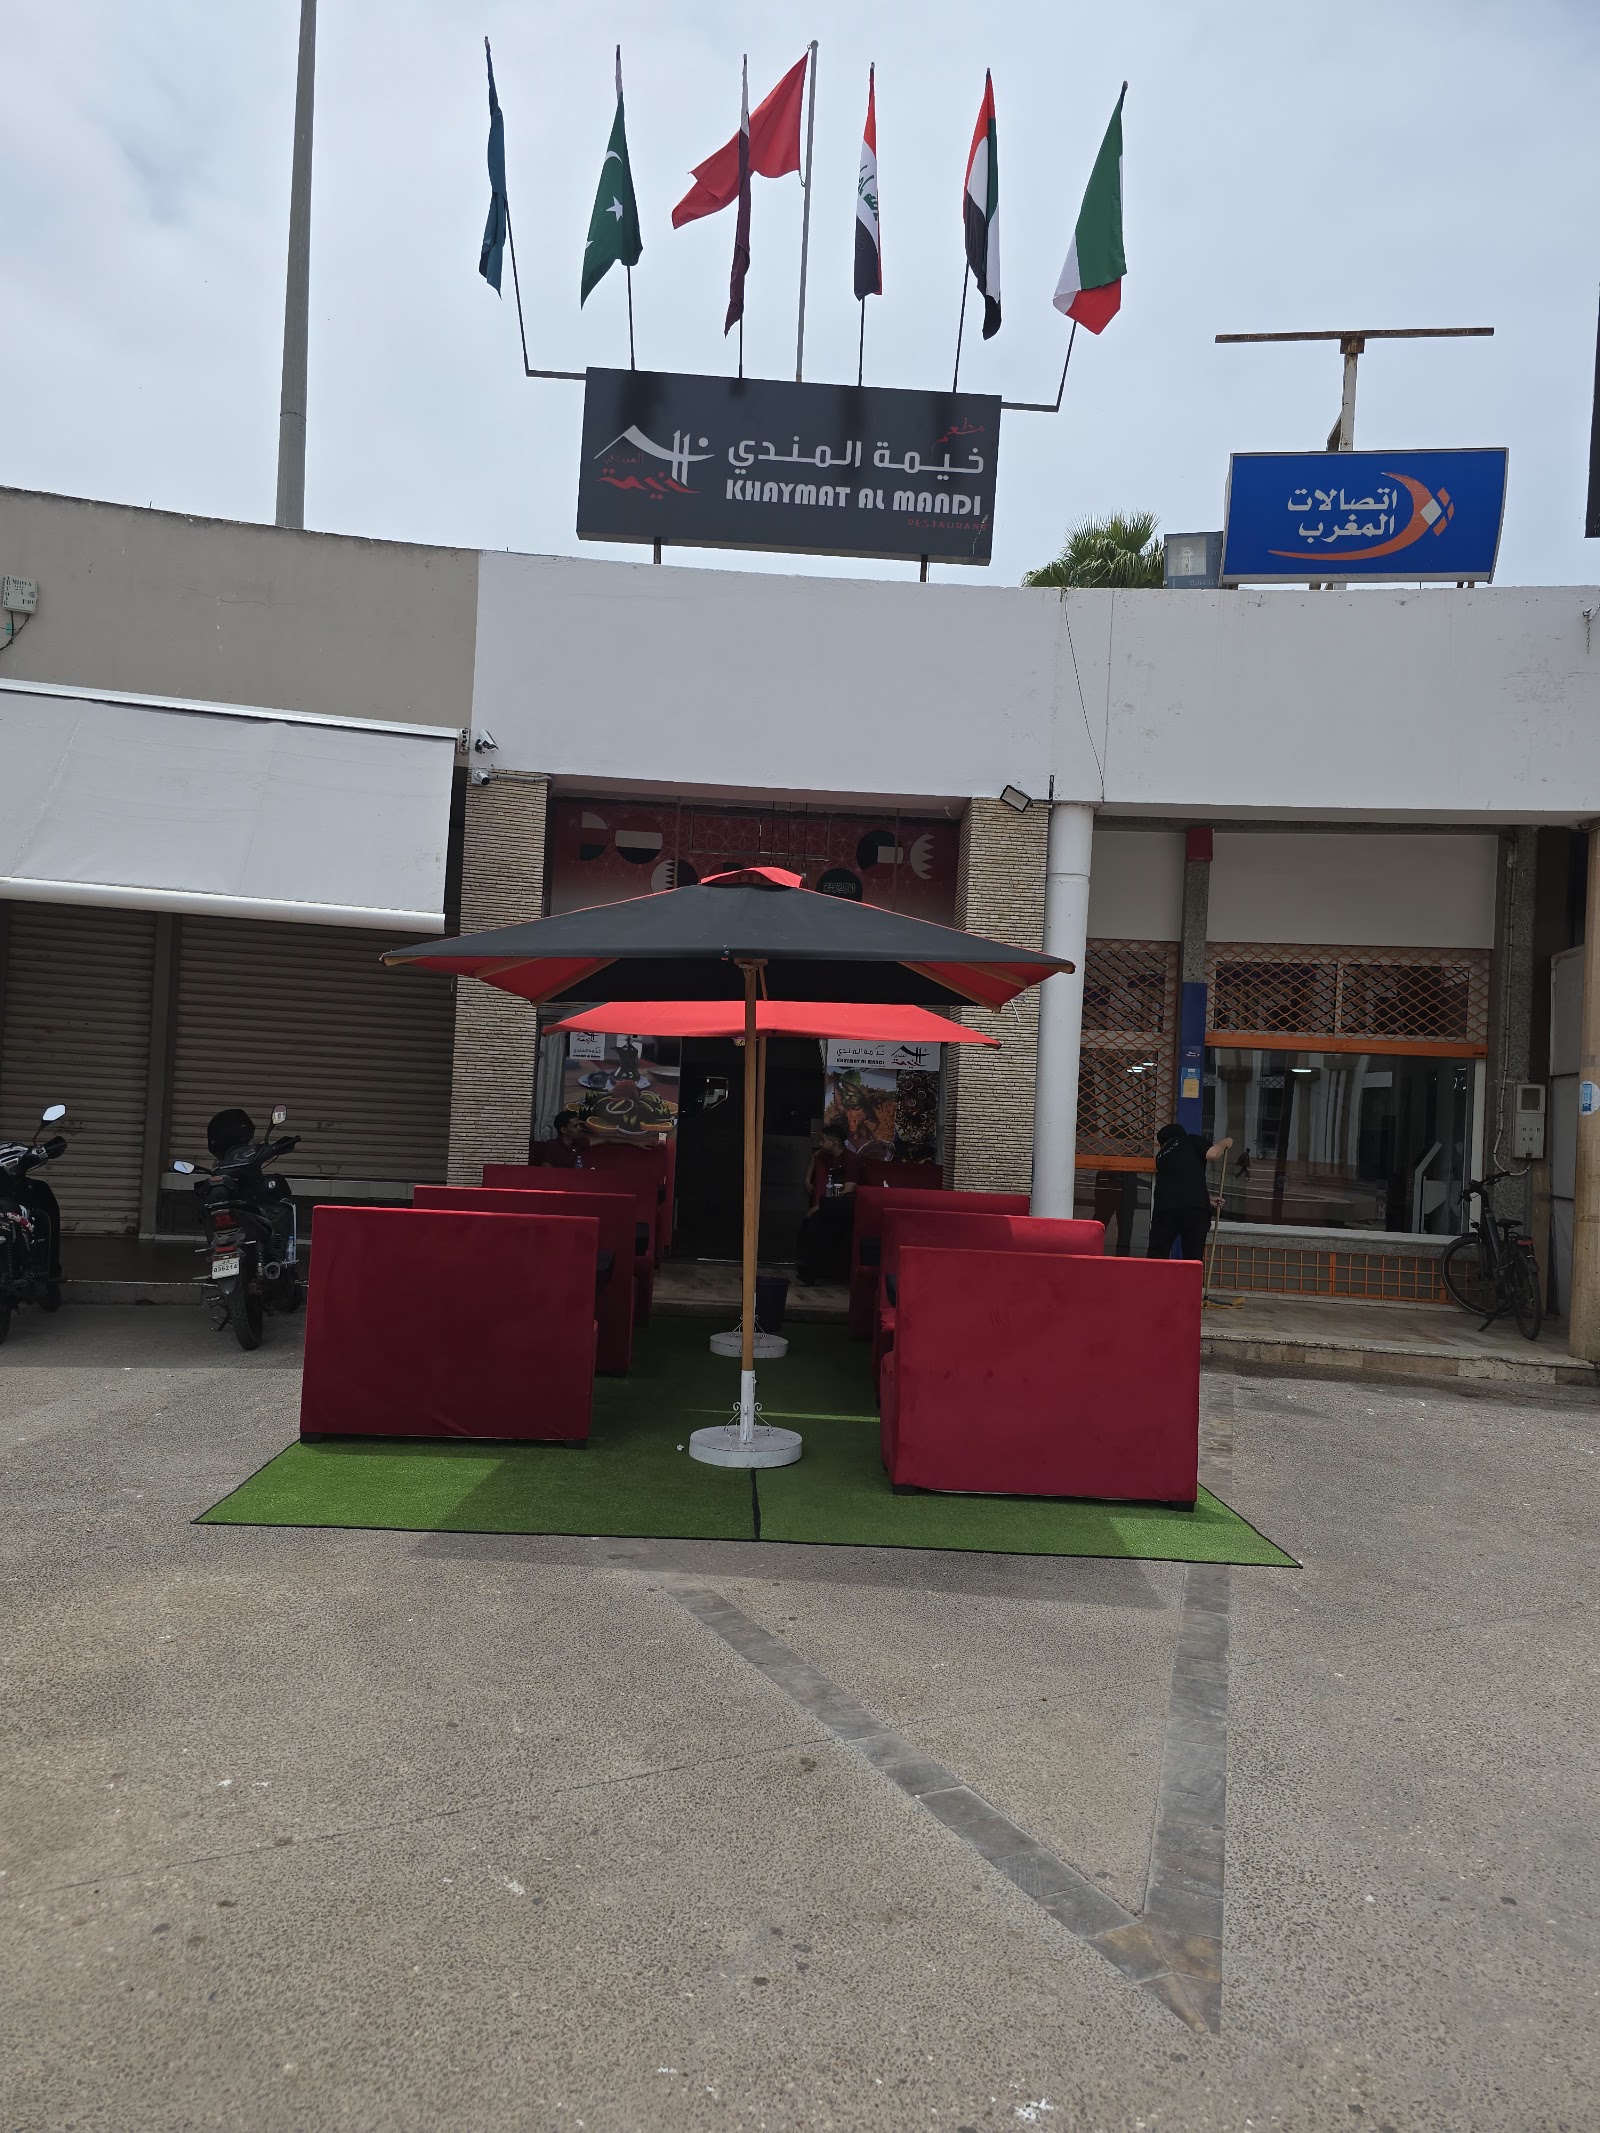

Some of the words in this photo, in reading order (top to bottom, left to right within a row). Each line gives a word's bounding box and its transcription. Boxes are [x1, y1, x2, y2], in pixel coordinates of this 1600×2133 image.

[728, 435, 862, 475] المندي
[873, 441, 984, 481] خيمة
[725, 479, 851, 508] KHAYMAT
[858, 488, 885, 510] AL
[892, 490, 981, 516] MANDI
[1287, 487, 1398, 511] اتصالات
[1298, 512, 1395, 544] المغرب
